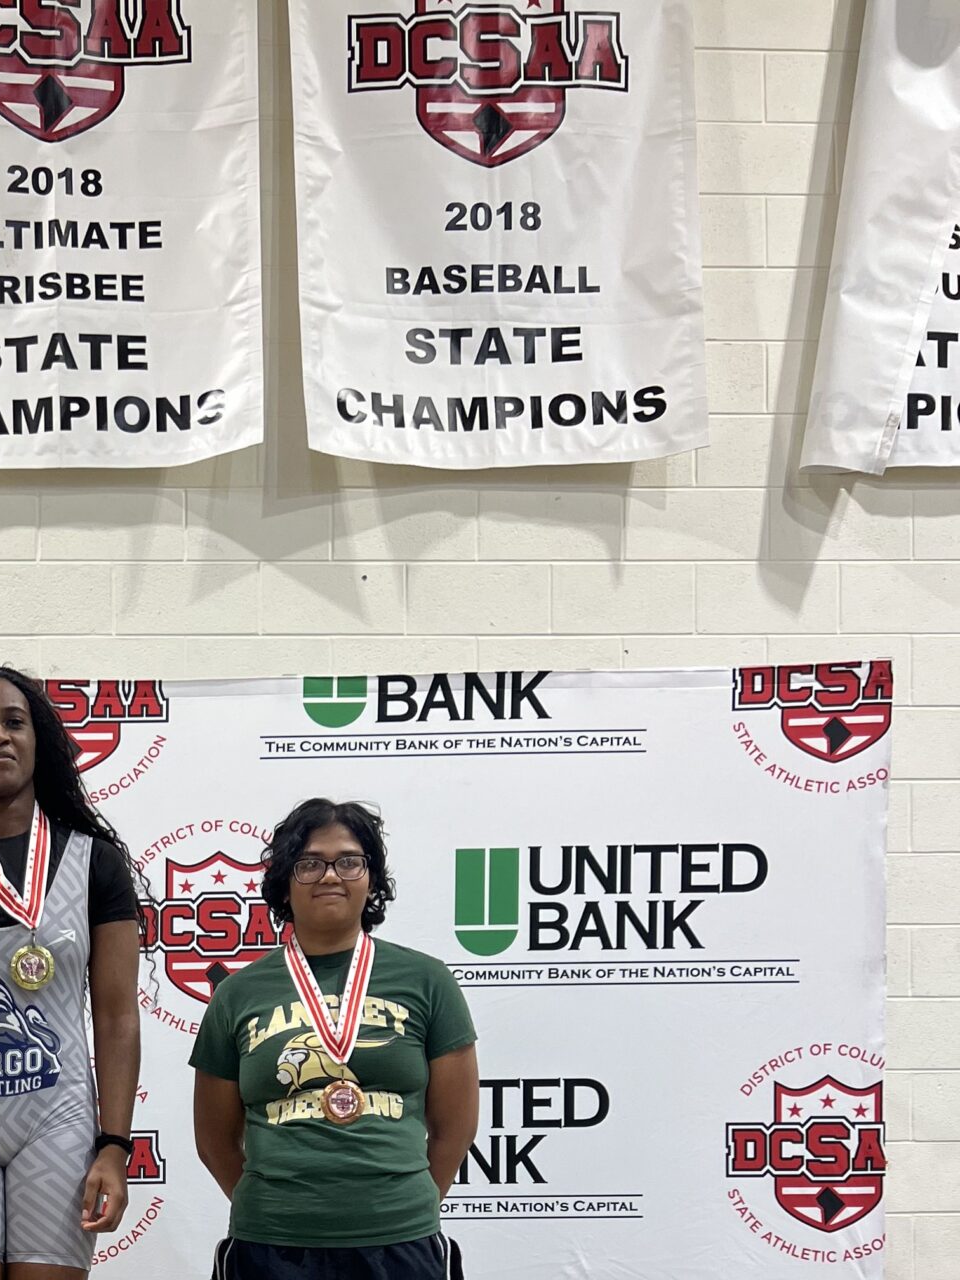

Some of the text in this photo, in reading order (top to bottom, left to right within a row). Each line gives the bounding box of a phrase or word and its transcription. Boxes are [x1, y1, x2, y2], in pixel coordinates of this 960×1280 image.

[348, 4, 628, 97] DCSAA
[7, 165, 103, 197] 2018
[445, 201, 541, 231] 2018
[386, 264, 601, 295] BASEBALL
[405, 326, 583, 365] STATE
[336, 385, 667, 432] CHAMPIONS
[375, 671, 552, 723] BANK
[733, 721, 767, 766] STATE
[765, 763, 840, 793] ATHLETIC
[201, 820, 224, 833] OF
[528, 843, 769, 896] UNITED
[527, 899, 705, 951] BANK
[248, 994, 410, 1053] LANGEY
[740, 1043, 832, 1097] DISTRICT OF
[726, 1115, 885, 1182] DCSA
[727, 1188, 763, 1233] STATE
[761, 1231, 836, 1263] ATHLETIC
